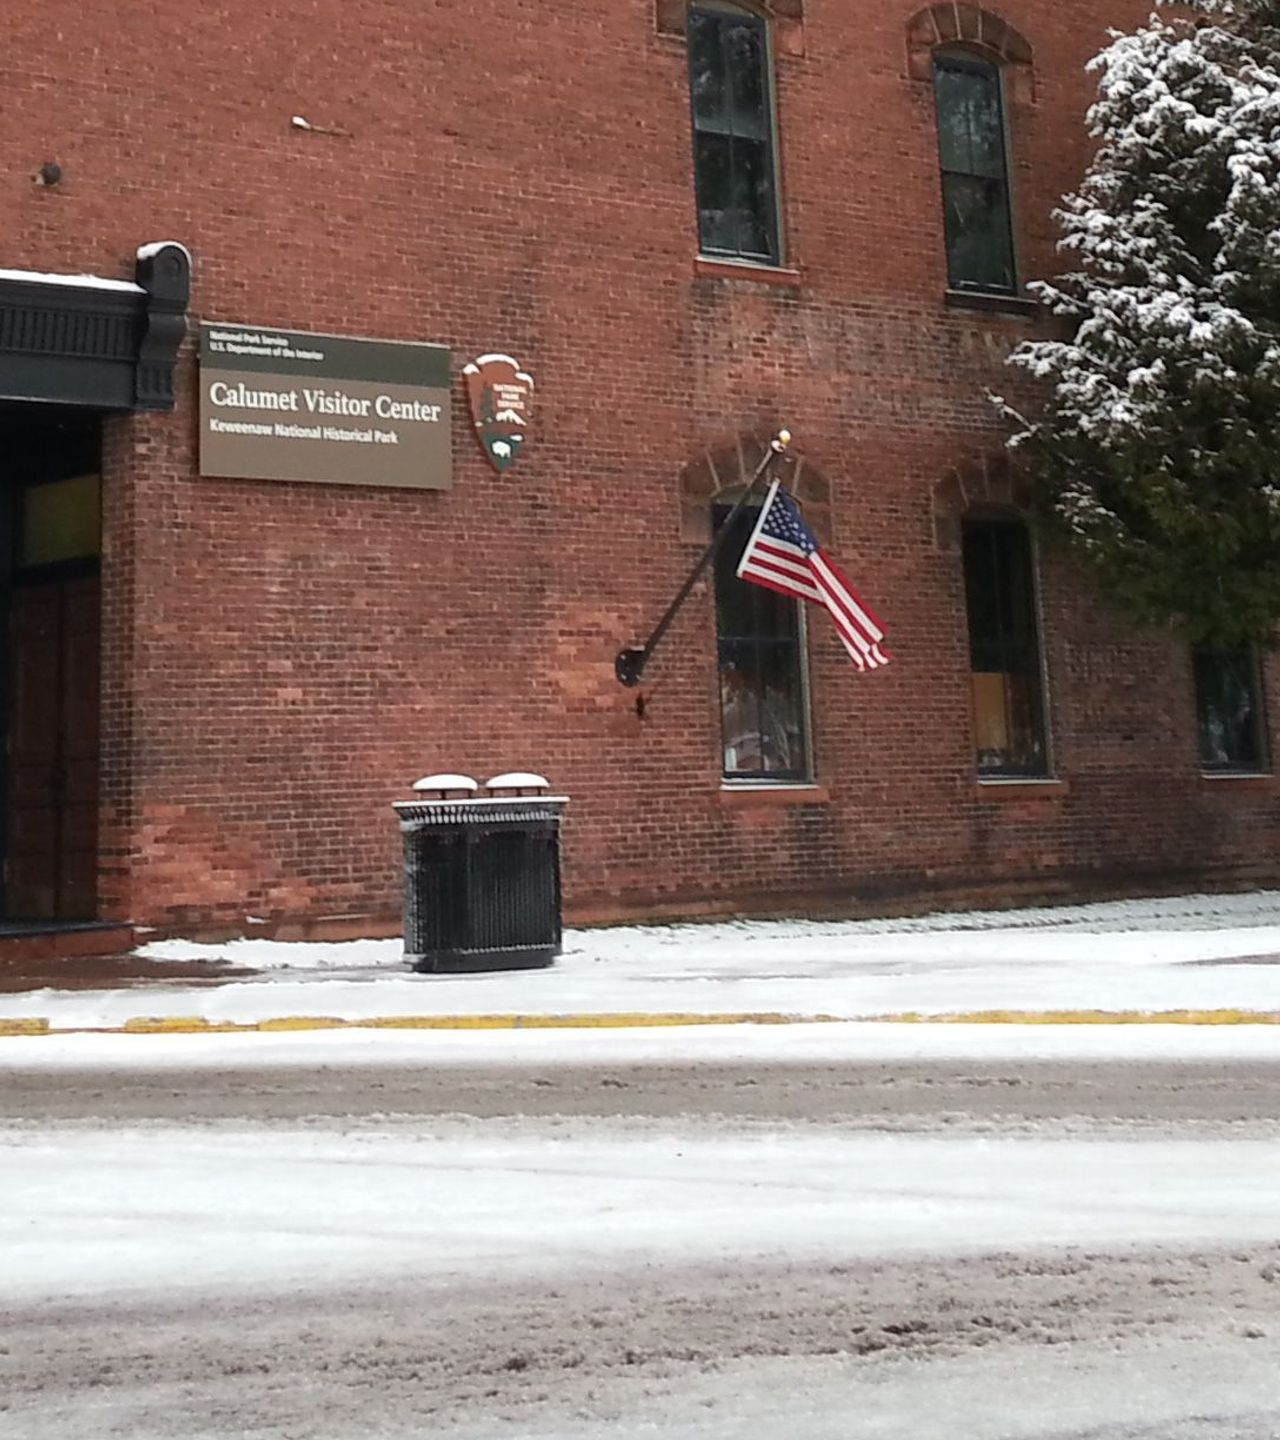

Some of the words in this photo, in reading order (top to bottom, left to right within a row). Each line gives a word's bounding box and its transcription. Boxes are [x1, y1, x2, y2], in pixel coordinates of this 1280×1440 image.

[209, 330, 243, 342] National
[244, 333, 261, 344] Park
[226, 343, 272, 356] Department
[209, 381, 299, 411] Calumet
[302, 388, 372, 418] Visitor
[375, 395, 442, 422] Center
[209, 418, 274, 436] Keweenaw
[274, 422, 322, 439] National
[323, 426, 373, 442] Historical
[374, 429, 399, 444] Park
